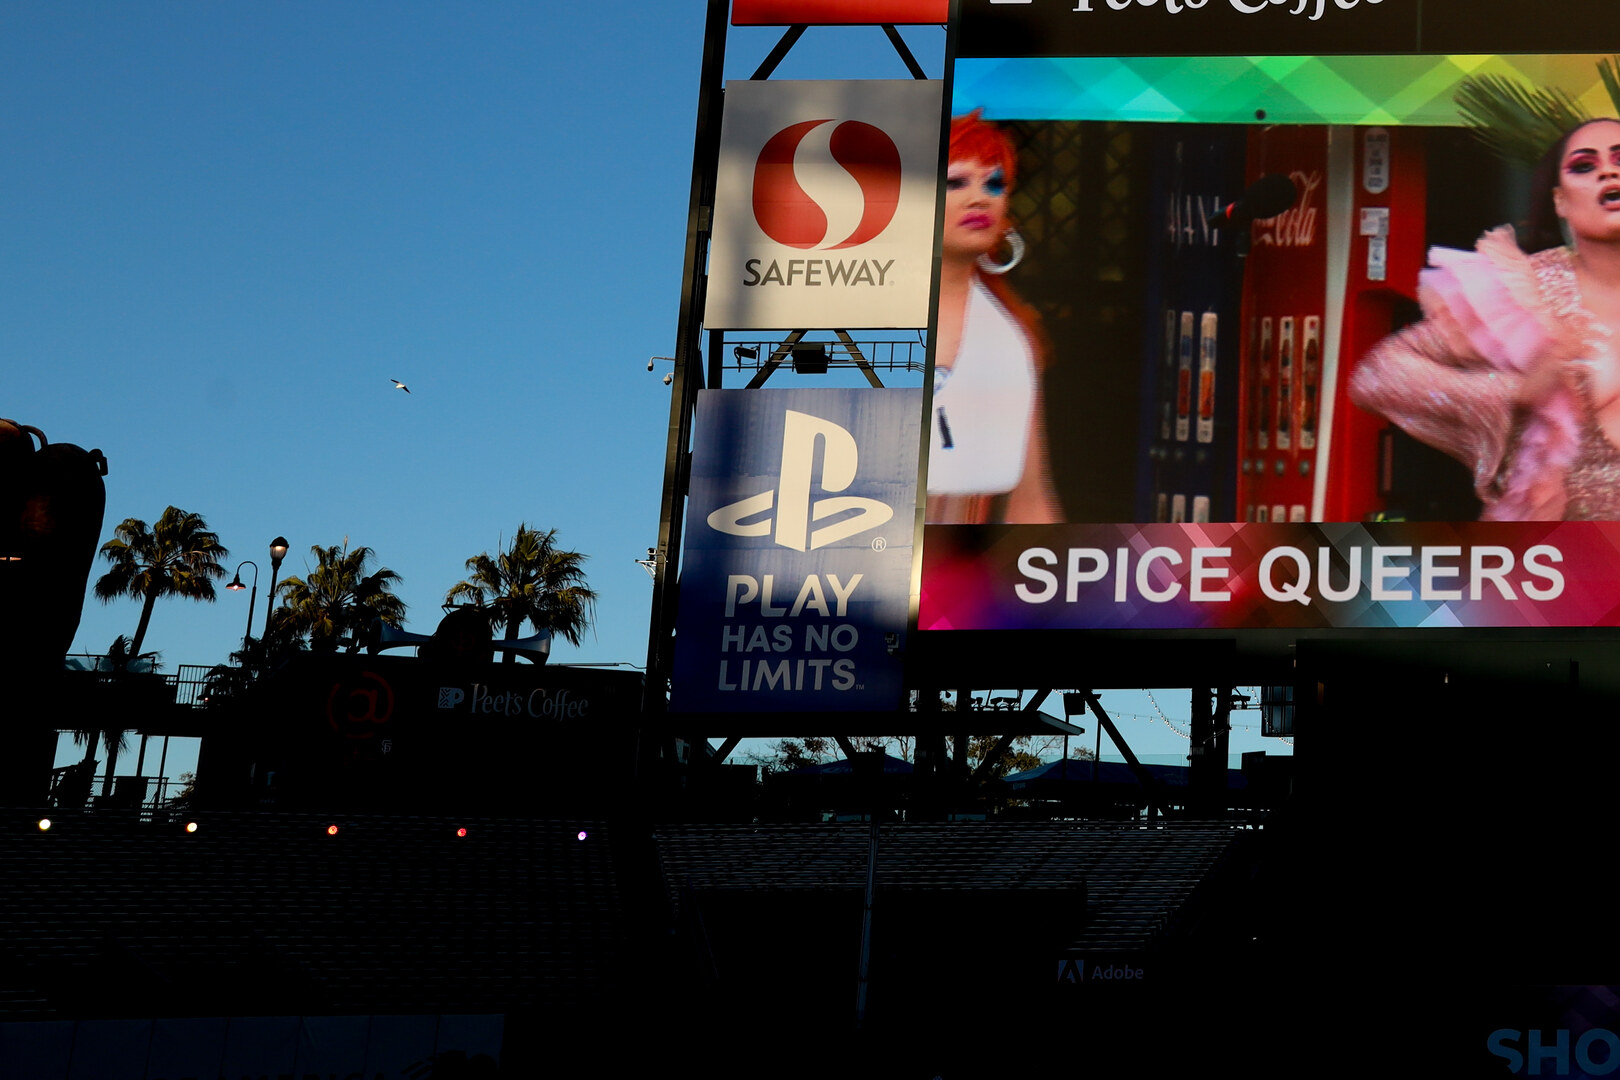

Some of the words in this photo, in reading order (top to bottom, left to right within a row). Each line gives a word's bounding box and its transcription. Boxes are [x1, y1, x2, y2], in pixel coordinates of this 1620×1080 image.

[743, 258, 895, 287] SAFEWAY
[1014, 547, 1232, 604] SPICE
[1258, 545, 1566, 607] QUEERS
[724, 574, 864, 617] PLAY
[721, 624, 792, 652] HAS
[804, 624, 859, 652] NO
[718, 659, 856, 691] LIMITS
[470, 683, 523, 718] Peet's
[527, 688, 590, 721] Coffee
[1091, 964, 1144, 980] Adobe
